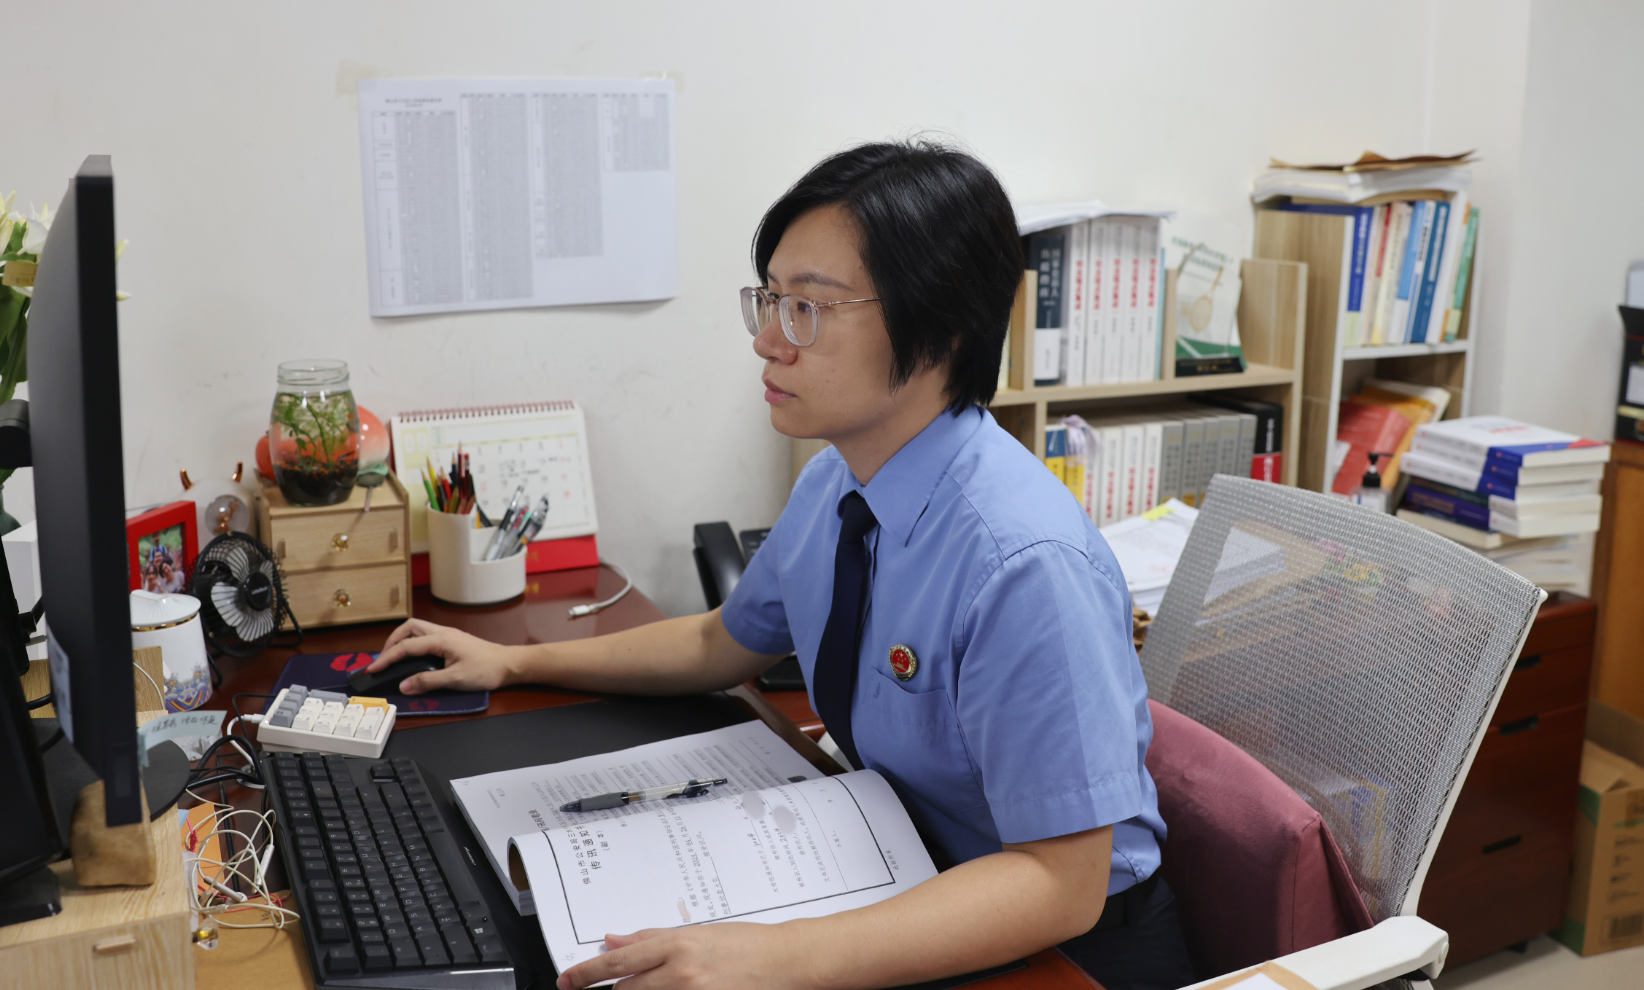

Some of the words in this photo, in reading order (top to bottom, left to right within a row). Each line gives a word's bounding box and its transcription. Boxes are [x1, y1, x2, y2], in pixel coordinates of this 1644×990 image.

[563, 827, 592, 886] 佛山市公安局三水
